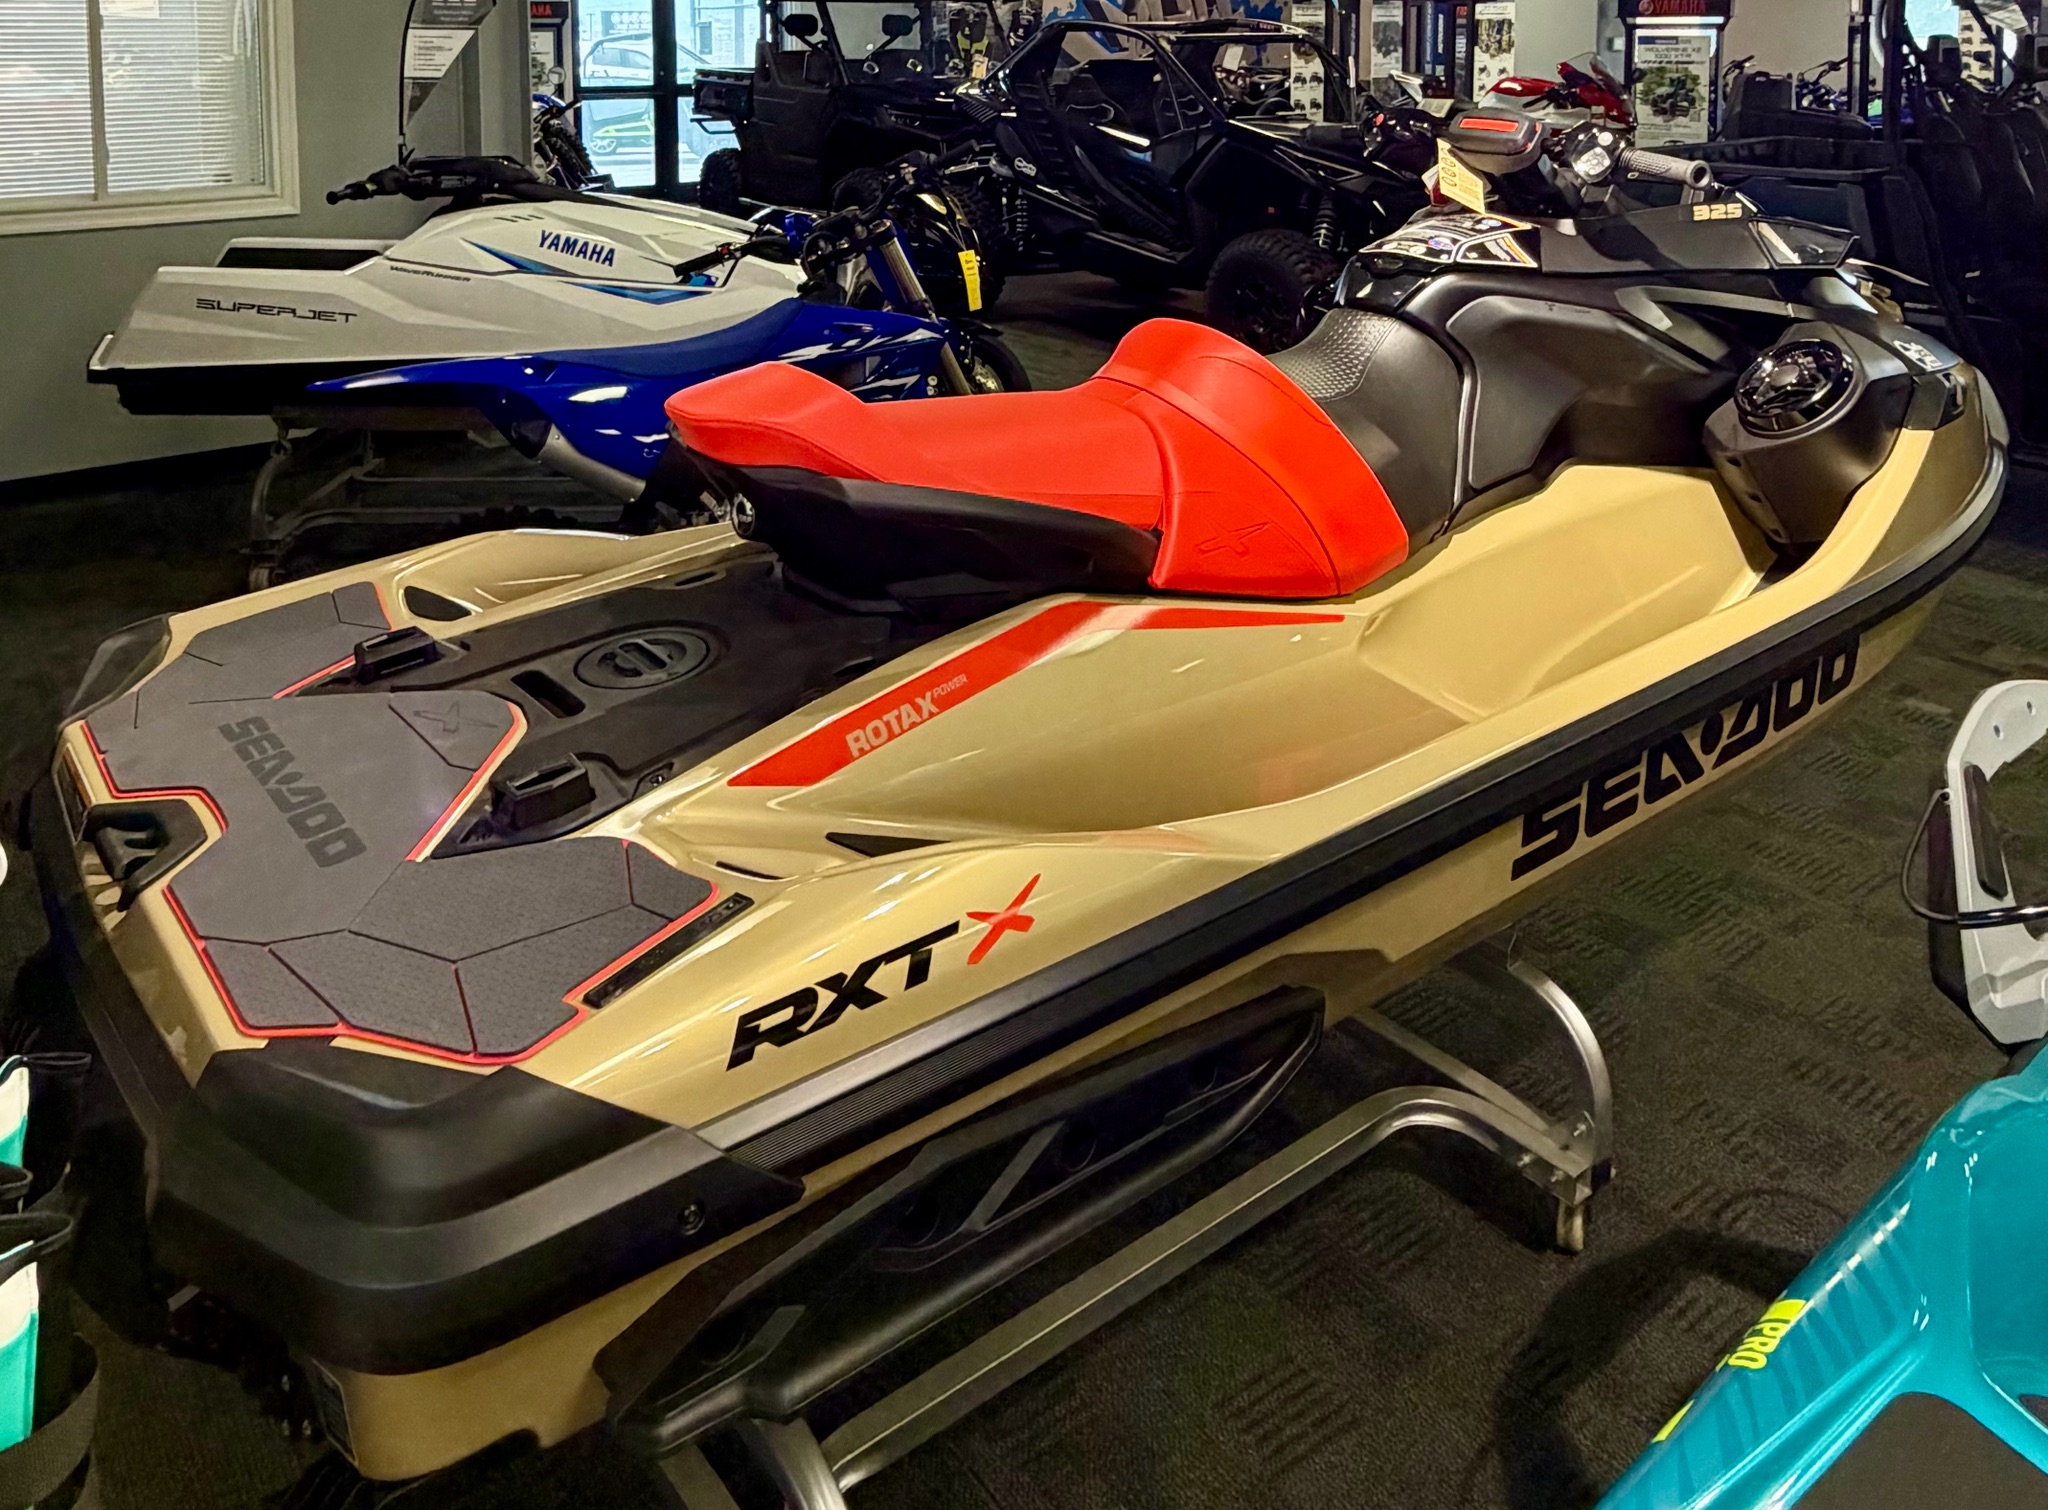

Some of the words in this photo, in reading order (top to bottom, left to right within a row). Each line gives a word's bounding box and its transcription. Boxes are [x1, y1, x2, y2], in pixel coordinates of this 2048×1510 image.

[1693, 203, 1742, 221] 325
[538, 230, 617, 268] YAMAHA
[195, 298, 358, 325] SUPERJET
[845, 691, 940, 758] ROTAX
[933, 673, 969, 698] POWER
[726, 919, 961, 1072] RXT
